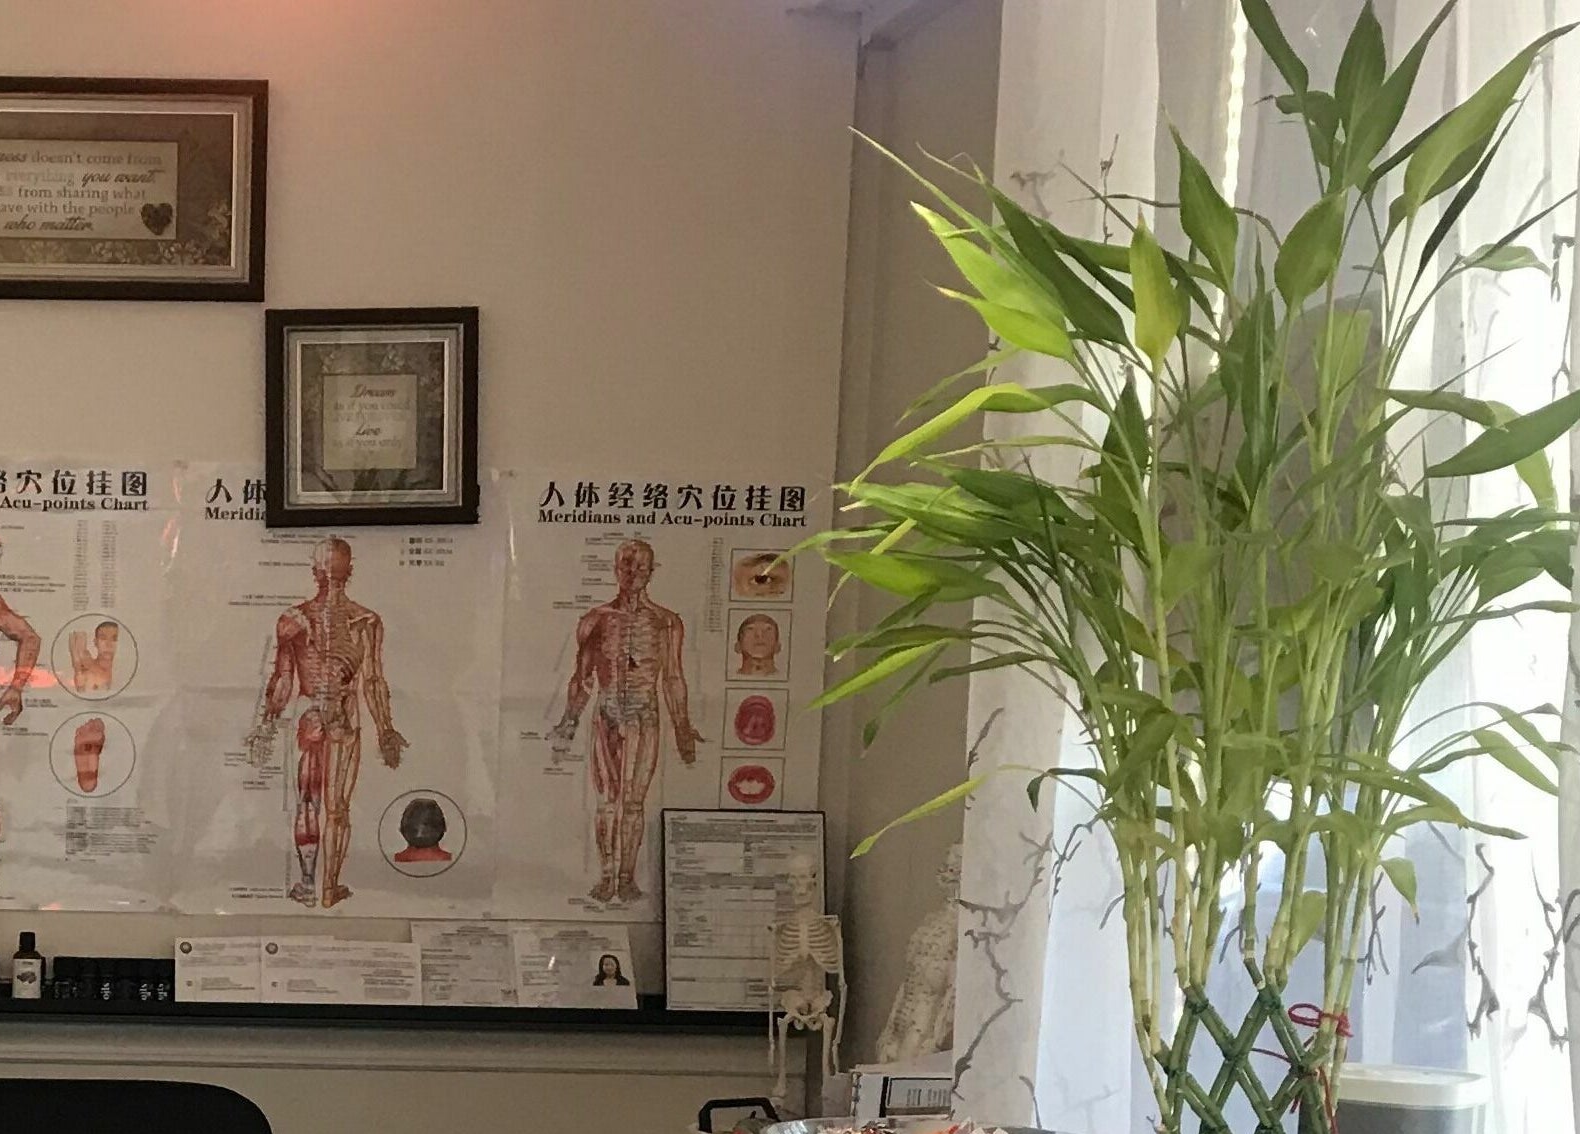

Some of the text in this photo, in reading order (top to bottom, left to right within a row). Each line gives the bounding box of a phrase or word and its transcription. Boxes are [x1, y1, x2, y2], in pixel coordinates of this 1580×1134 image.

[31, 151, 83, 163] doesn't
[86, 154, 124, 164] come
[127, 152, 162, 165] from
[81, 172, 110, 187] you
[18, 187, 52, 198] from
[57, 186, 109, 202] sharing
[112, 186, 145, 199] what
[27, 201, 58, 213] with
[62, 201, 85, 213] the
[89, 200, 135, 218] people
[3, 213, 36, 230] who
[0, 497, 96, 512] Acu-points
[101, 497, 150, 511] Chart
[539, 481, 807, 512] 人体经络穴位挂图
[204, 506, 267, 521] Meridi
[538, 509, 807, 528] Meridians and Acu-points Chart
